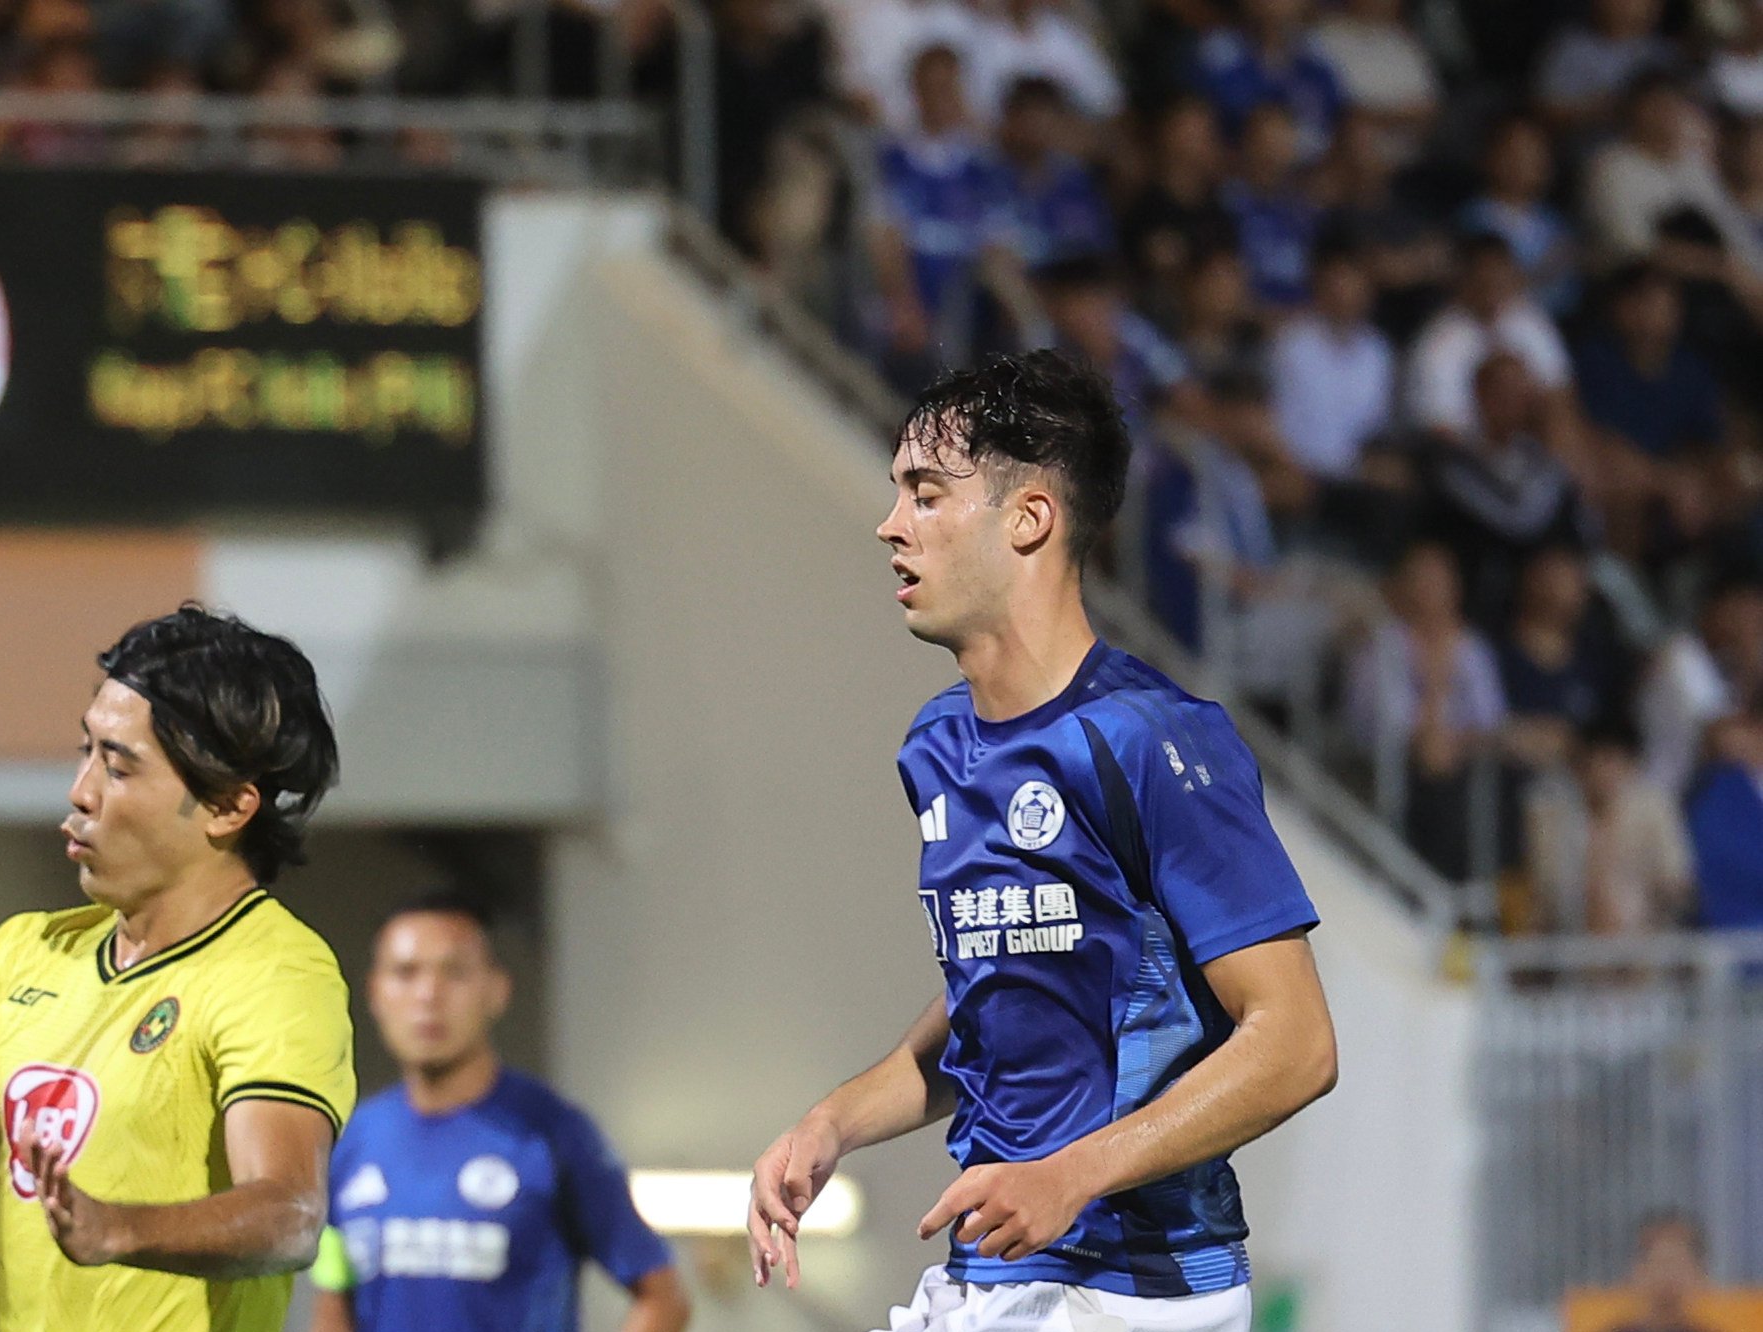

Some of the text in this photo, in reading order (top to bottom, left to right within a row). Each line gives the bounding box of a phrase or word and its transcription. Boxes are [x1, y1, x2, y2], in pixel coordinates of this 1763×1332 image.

[950, 883, 1079, 929] 美建集團
[1005, 923, 1083, 955] GROUP
